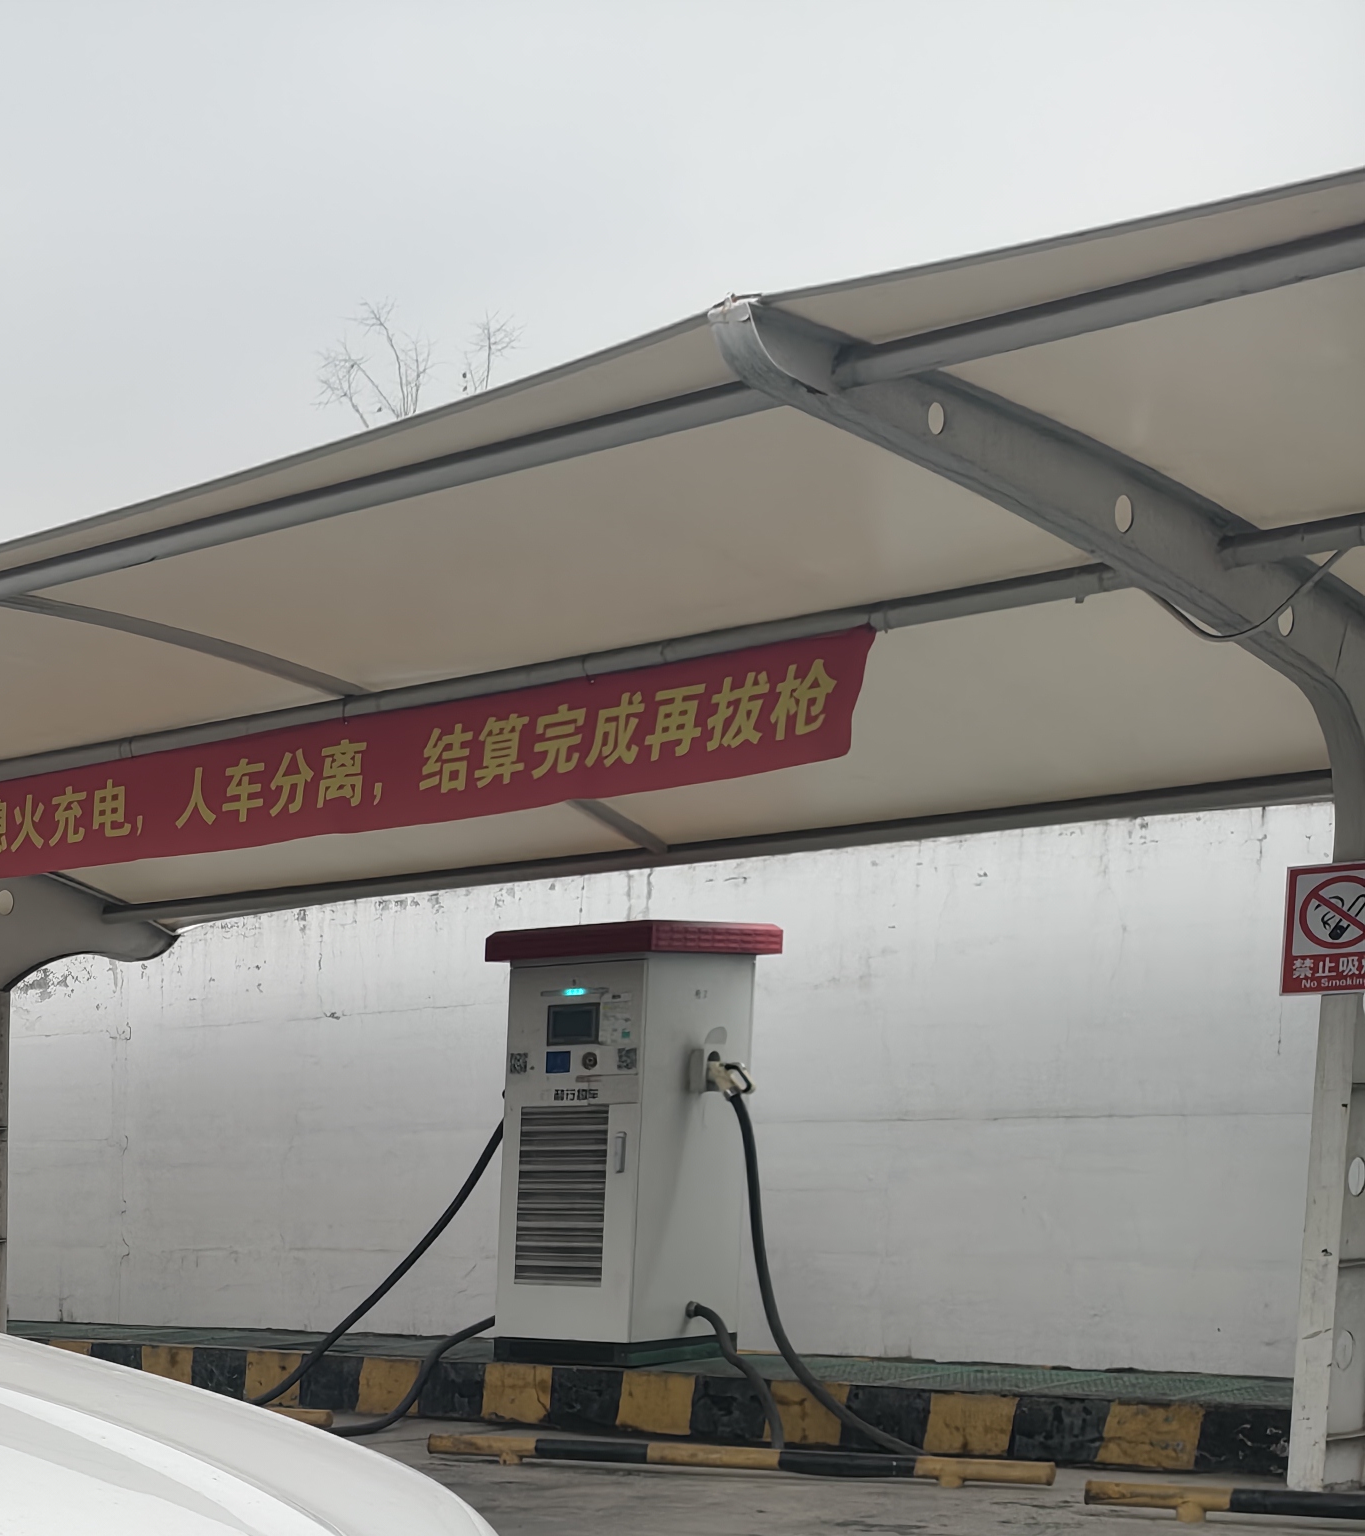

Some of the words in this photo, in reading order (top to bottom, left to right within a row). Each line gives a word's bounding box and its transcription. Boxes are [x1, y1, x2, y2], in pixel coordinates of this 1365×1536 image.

[1293, 956, 1365, 979] 禁止吸
[1301, 979, 1318, 989] No
[1321, 976, 1365, 988] Smokin
